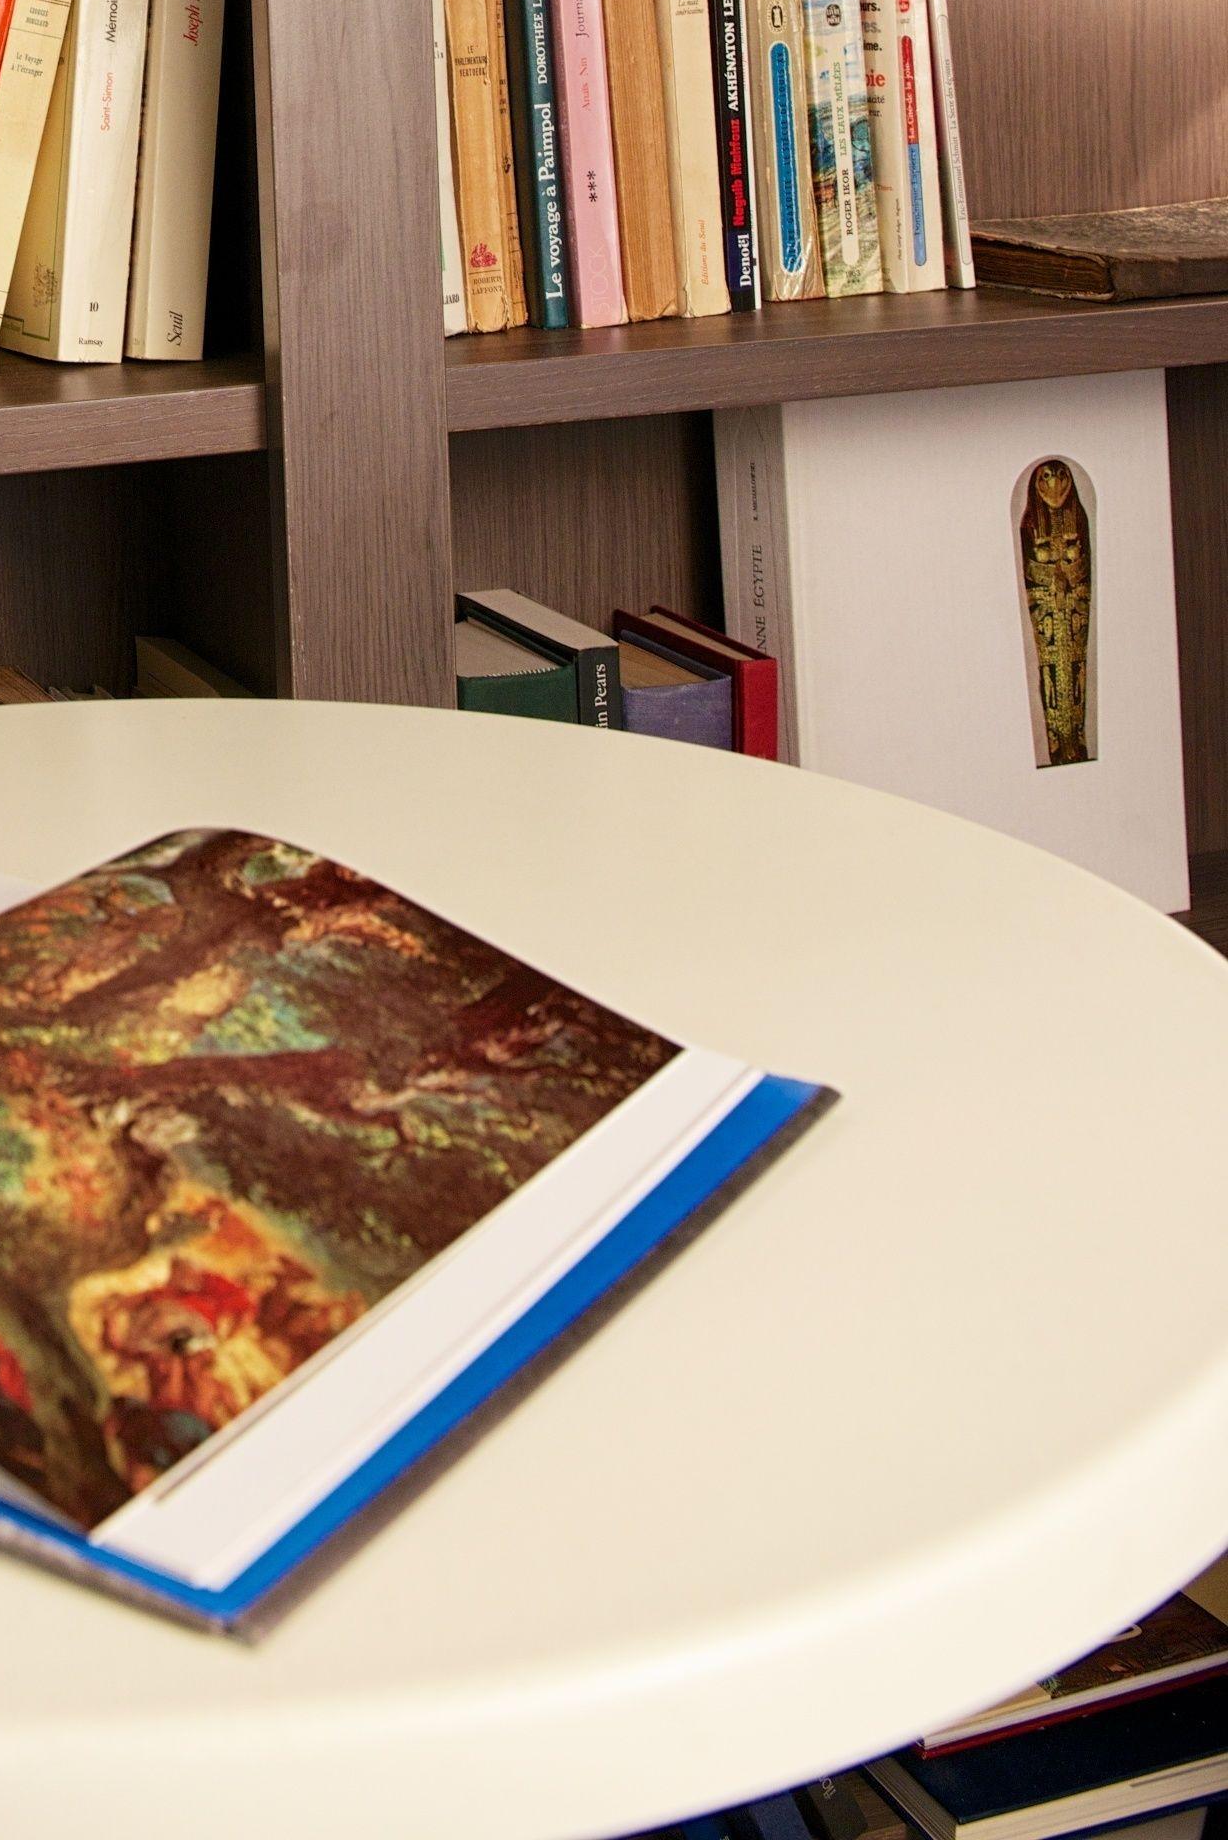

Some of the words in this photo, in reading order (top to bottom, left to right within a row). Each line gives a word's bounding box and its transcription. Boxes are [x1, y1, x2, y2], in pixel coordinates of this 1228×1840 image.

[532, 12, 548, 85] DOROTHÉE
[723, 21, 740, 112] AKHÉNATON
[100, 71, 114, 132] Saint-Simon
[533, 101, 558, 183] Paimpol
[729, 117, 743, 176] Mahfouz
[540, 184, 557, 198] à
[730, 178, 748, 228] Naguib
[546, 202, 562, 267] voyage
[472, 275, 503, 286] ROBERT
[737, 232, 753, 288] Denoël
[88, 301, 100, 314] 10
[471, 284, 504, 297] LAFFONT
[545, 273, 564, 300] Le
[77, 335, 104, 347] Ramsay
[166, 310, 184, 347] Seuil
[594, 663, 608, 708] Pears
